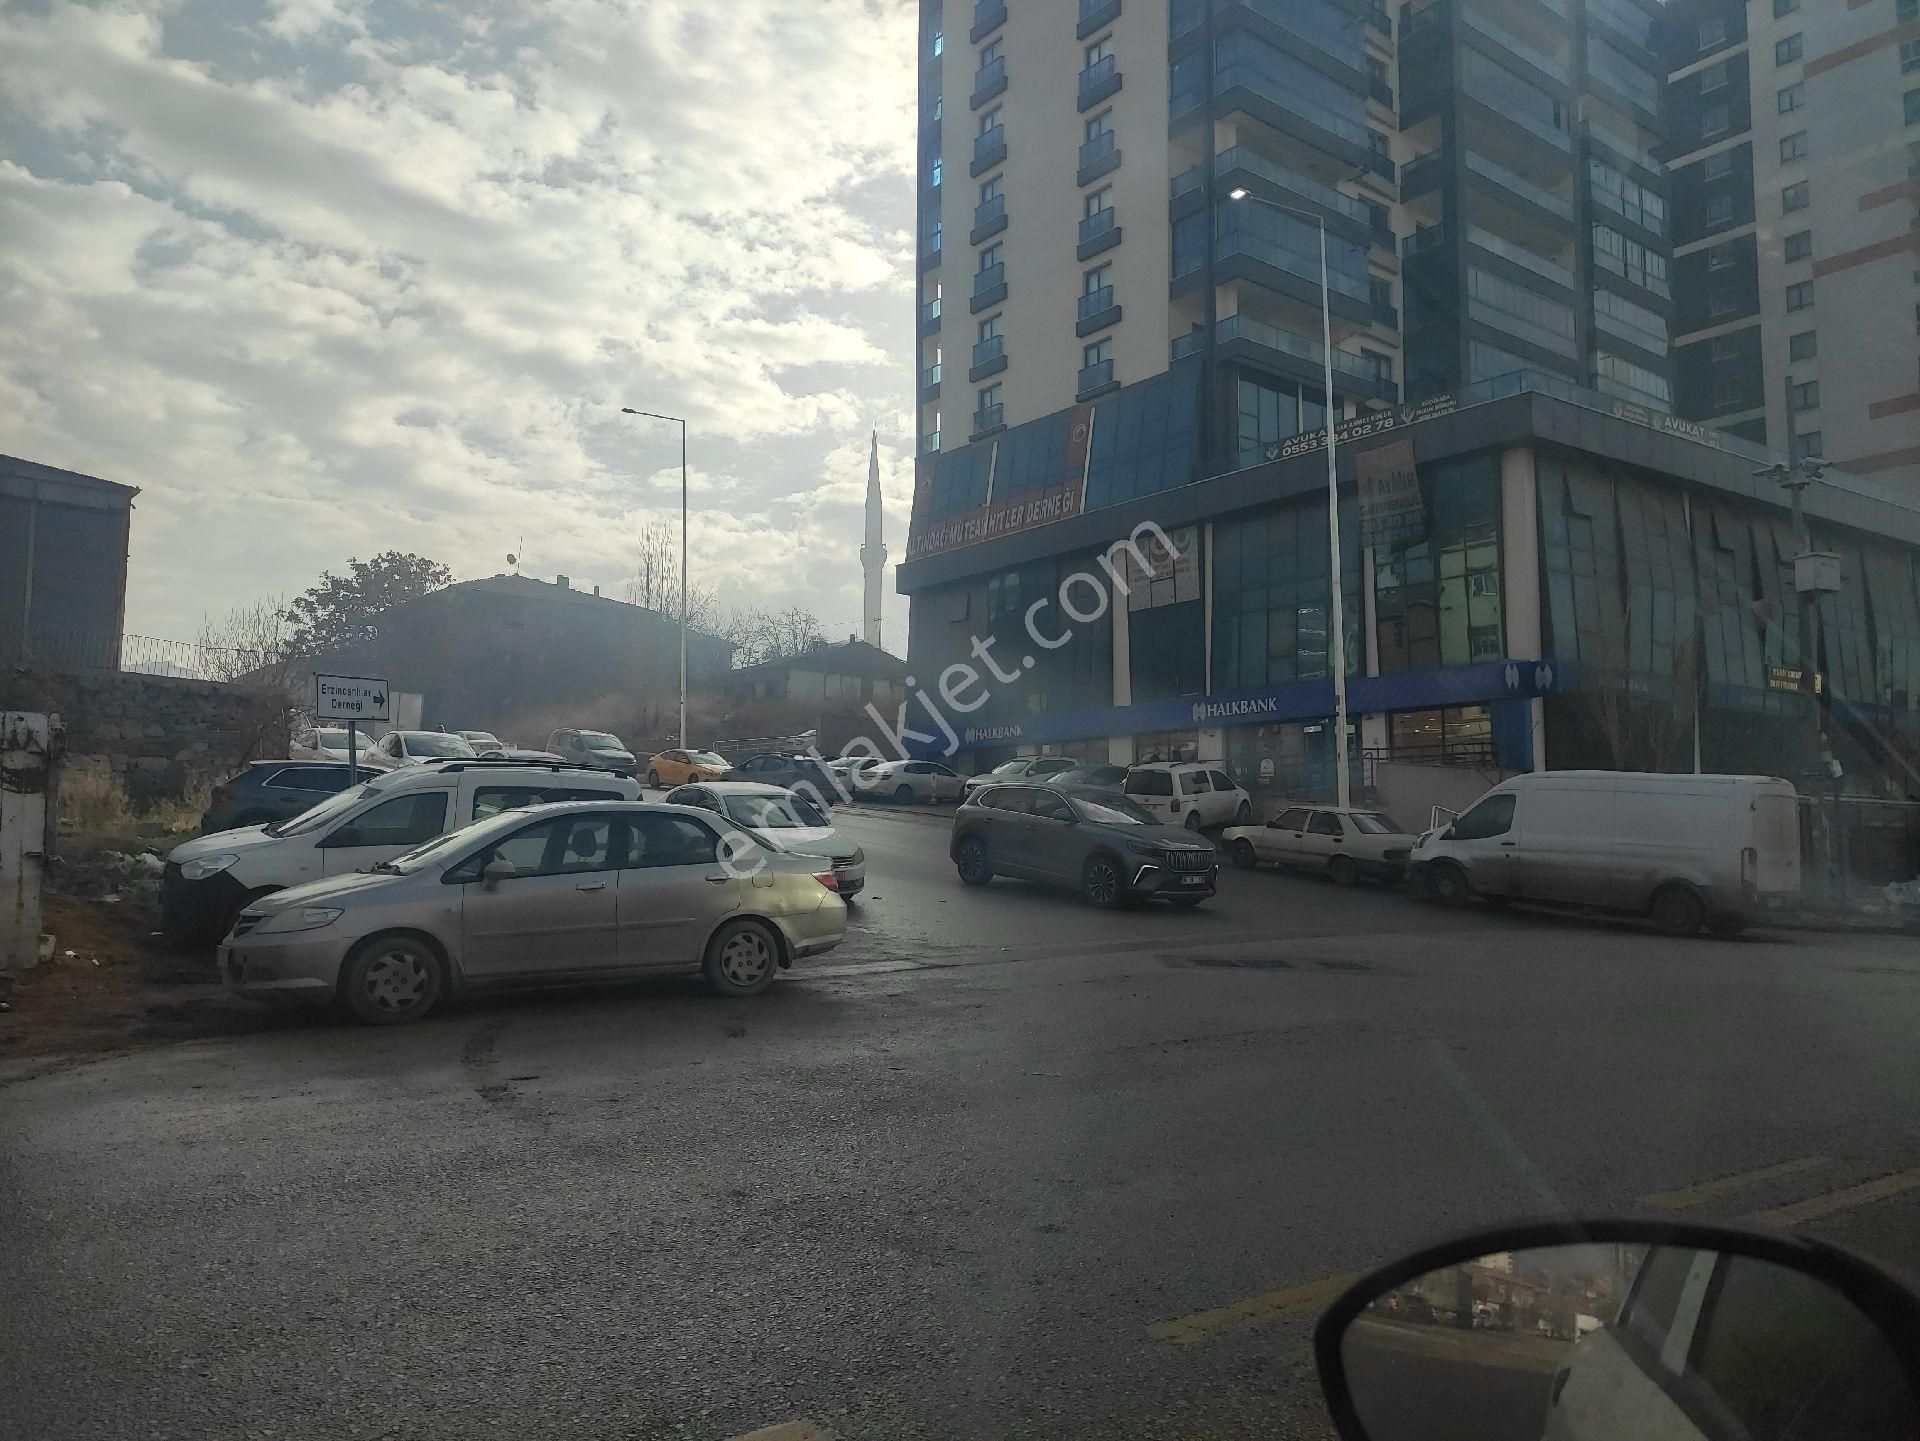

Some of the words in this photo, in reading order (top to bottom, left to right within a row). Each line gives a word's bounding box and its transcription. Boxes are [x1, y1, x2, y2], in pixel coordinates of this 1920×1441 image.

[1282, 439, 1317, 456] 0553
[1352, 425, 1372, 437] 02
[1375, 418, 1394, 431] 78
[1664, 416, 1704, 437] AVUKAT
[1284, 429, 1328, 447] AVUKA
[1207, 696, 1278, 718] HALKBANK
[975, 724, 1024, 741] HALKBANK
